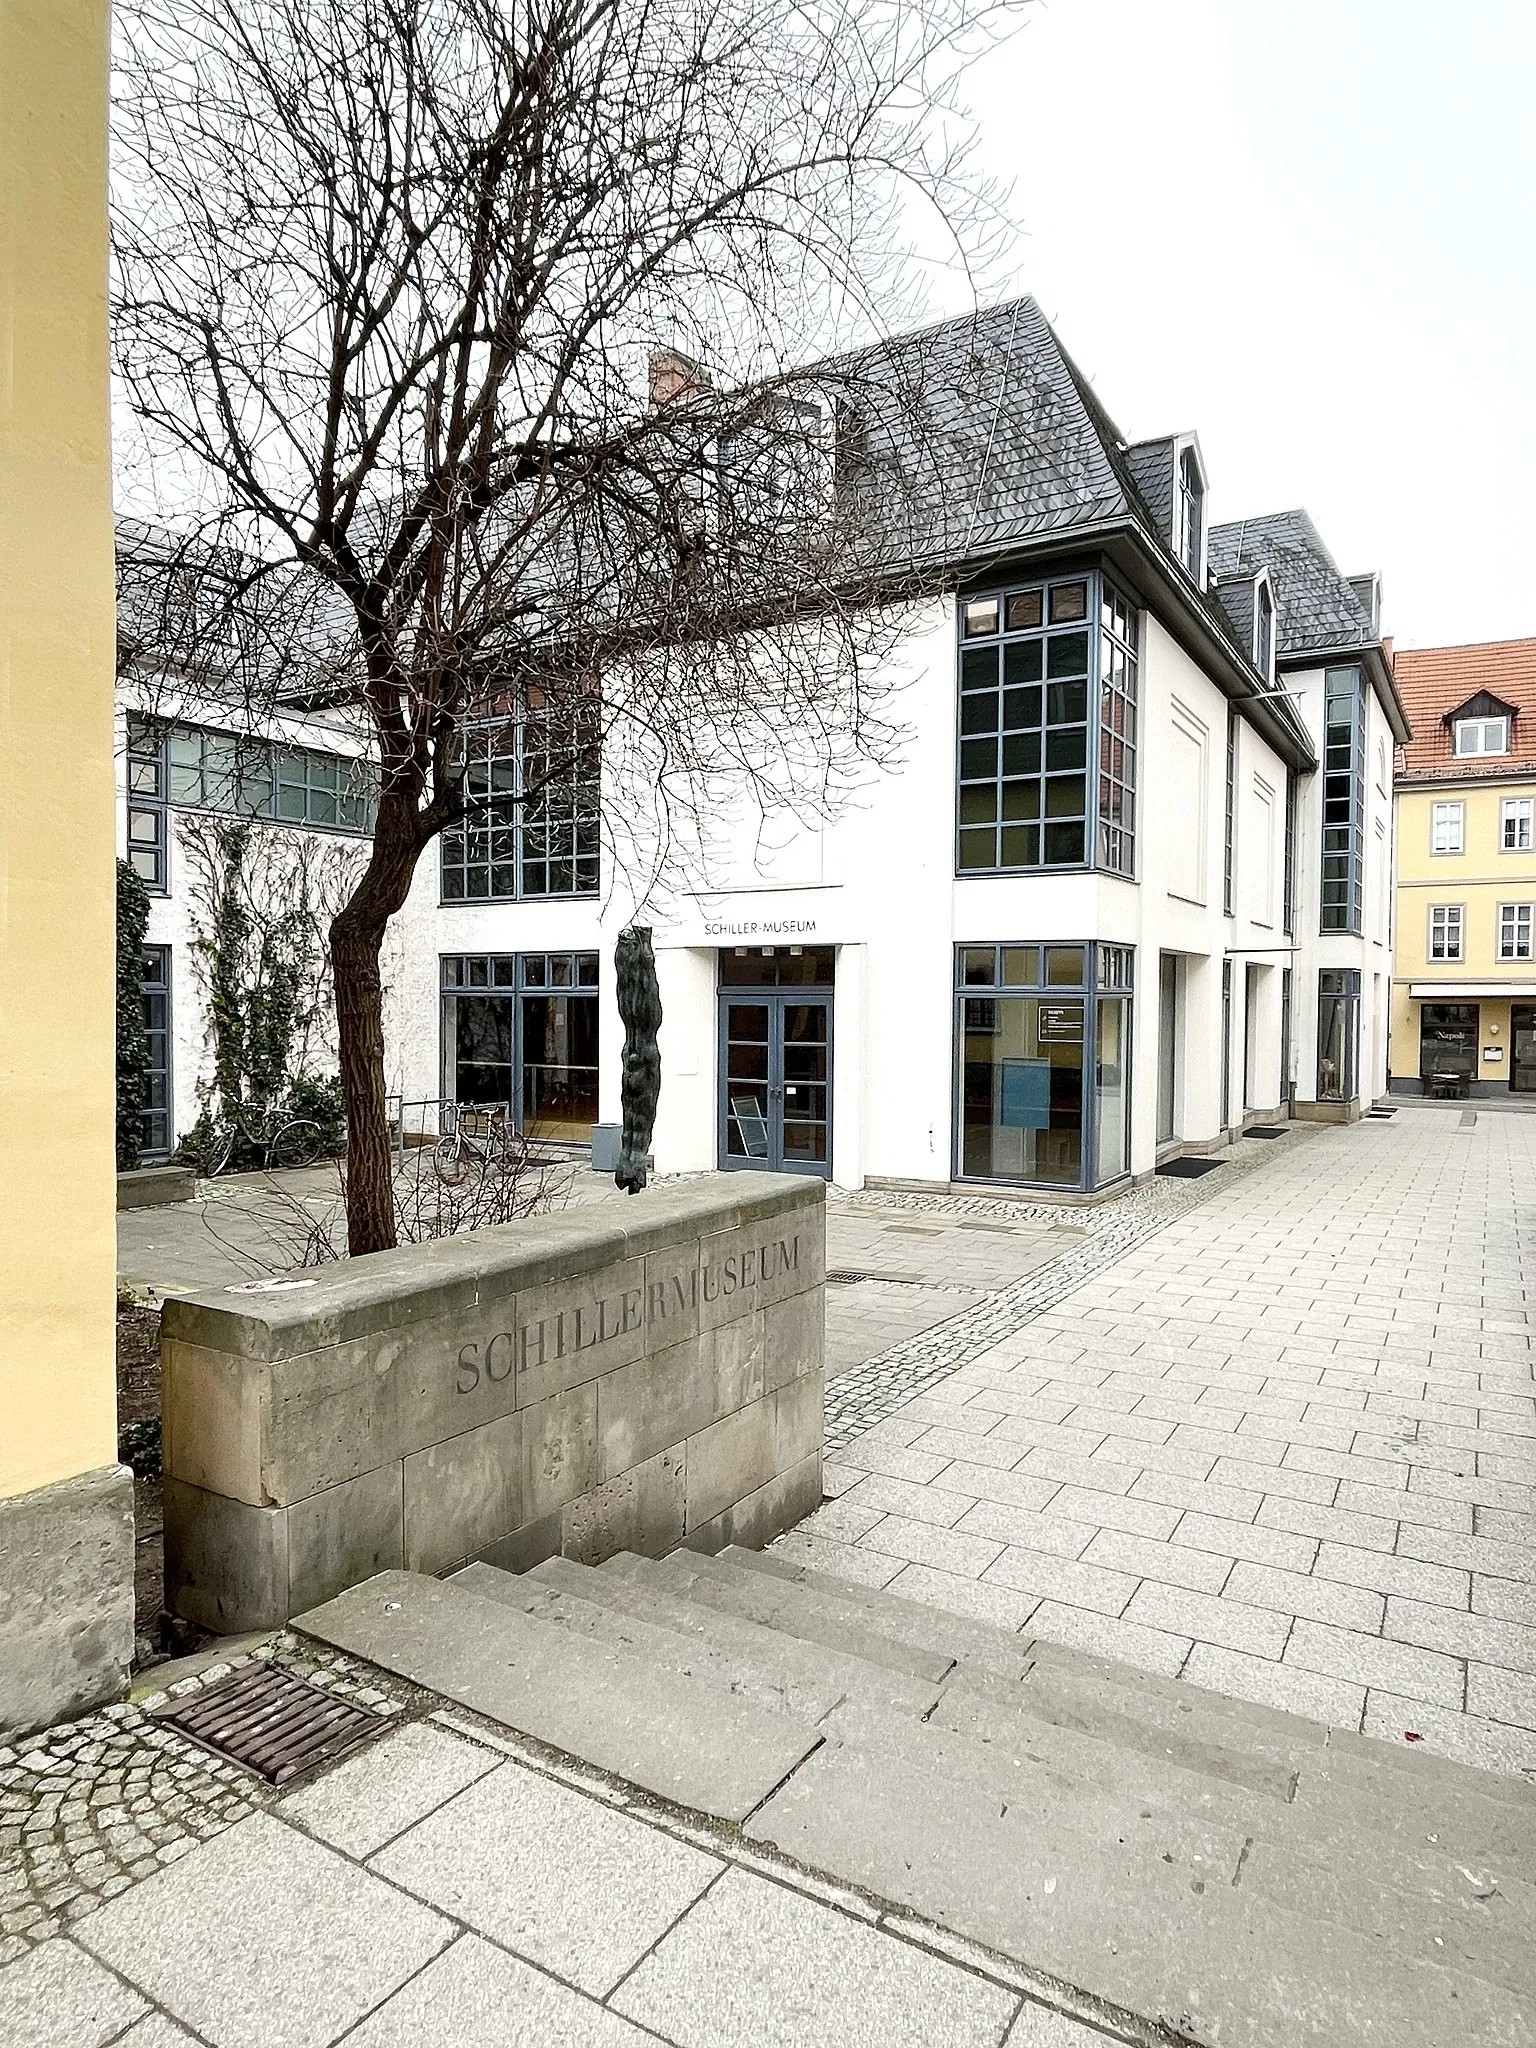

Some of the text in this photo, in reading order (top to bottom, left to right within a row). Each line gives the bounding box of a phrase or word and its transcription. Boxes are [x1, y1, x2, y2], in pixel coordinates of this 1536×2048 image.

[704, 920, 816, 935] SCHILLER-MUSEUM
[1435, 1030, 1465, 1041] Napoli
[456, 1235, 800, 1395] SCHILLERMUSEUM
